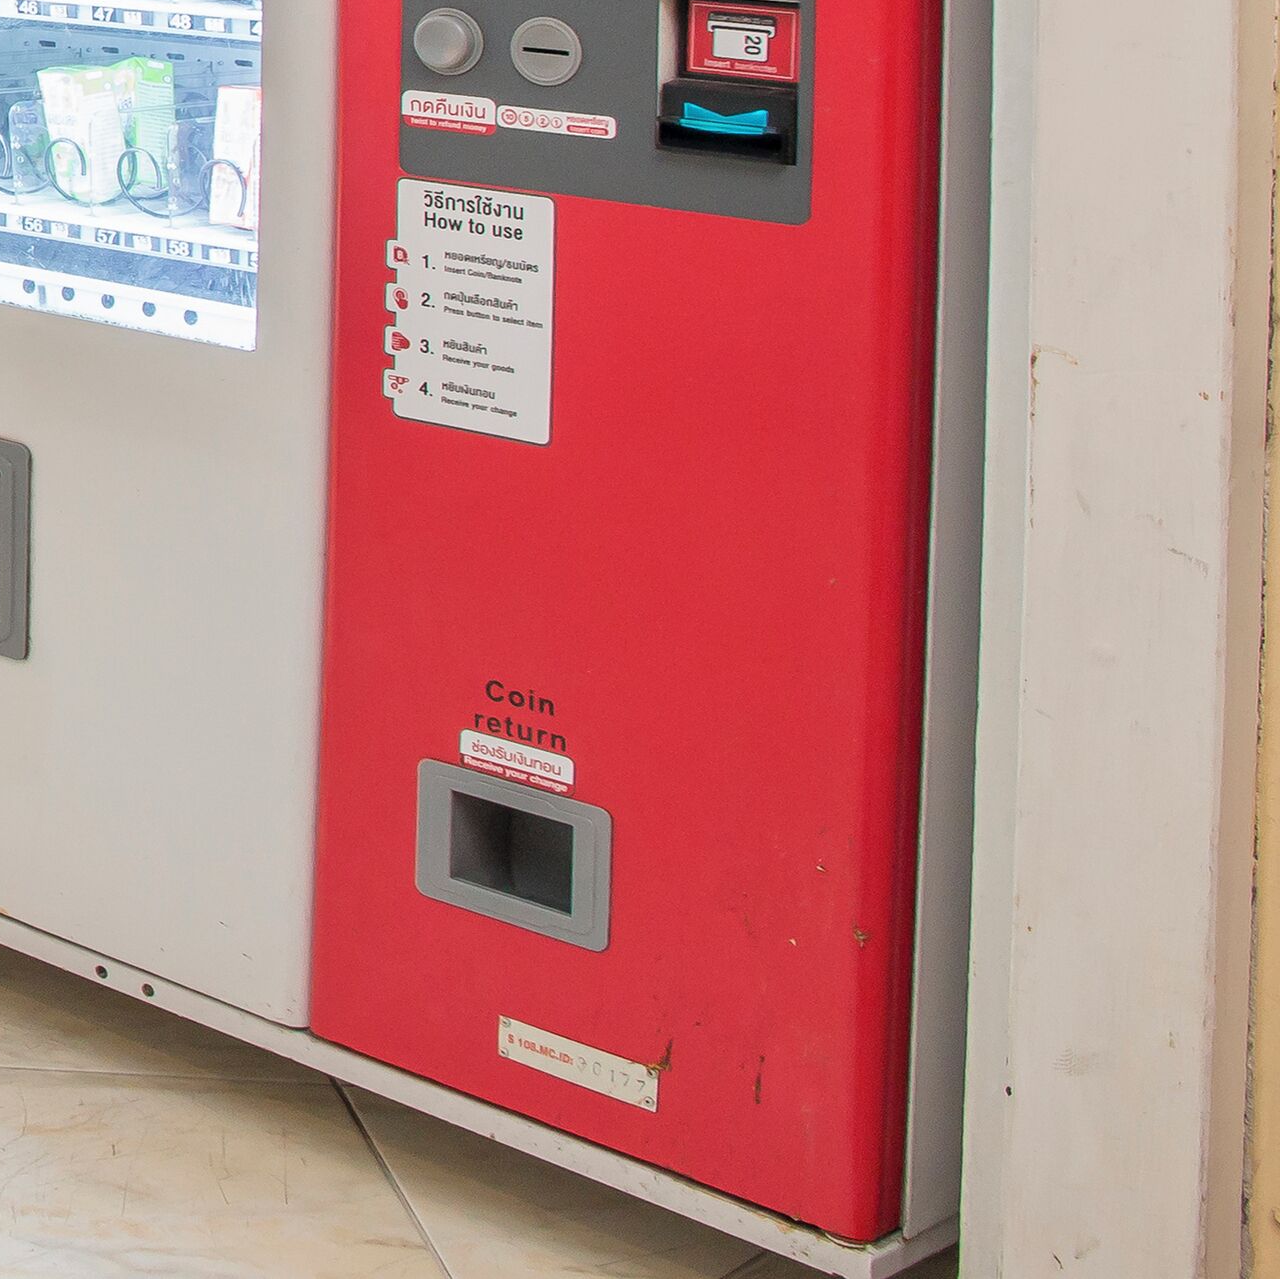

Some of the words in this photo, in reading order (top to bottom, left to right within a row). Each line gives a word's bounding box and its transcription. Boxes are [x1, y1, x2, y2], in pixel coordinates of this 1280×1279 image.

[18, 0, 38, 14] 46
[93, 7, 114, 22] 47
[171, 14, 191, 29] 48
[744, 35, 761, 55] 20
[410, 98, 486, 119] กดคืนเงิน
[424, 190, 524, 220] วิธีการใช้งาน
[23, 217, 43, 232] 56
[424, 211, 462, 231] How
[469, 218, 485, 234] to
[493, 224, 523, 240] use
[97, 230, 118, 245] 57
[169, 241, 191, 256] 58
[422, 255, 436, 270] 1.
[420, 292, 435, 308] 2.
[444, 306, 464, 315] Press
[467, 310, 491, 320] button
[502, 316, 524, 326] select
[526, 320, 543, 329] item
[420, 339, 434, 354] 3.
[442, 354, 470, 366] Receive
[473, 360, 489, 369] your
[492, 363, 515, 374] goods
[419, 382, 433, 397] 4.
[441, 397, 469, 408] Receive
[471, 402, 488, 411] your
[490, 405, 517, 417] change
[485, 680, 554, 716] Coin
[474, 713, 566, 752] return
[471, 739, 562, 776] ช่องรับเงินทอน
[463, 755, 503, 774] Receive
[504, 766, 529, 780] your
[529, 775, 568, 792] change
